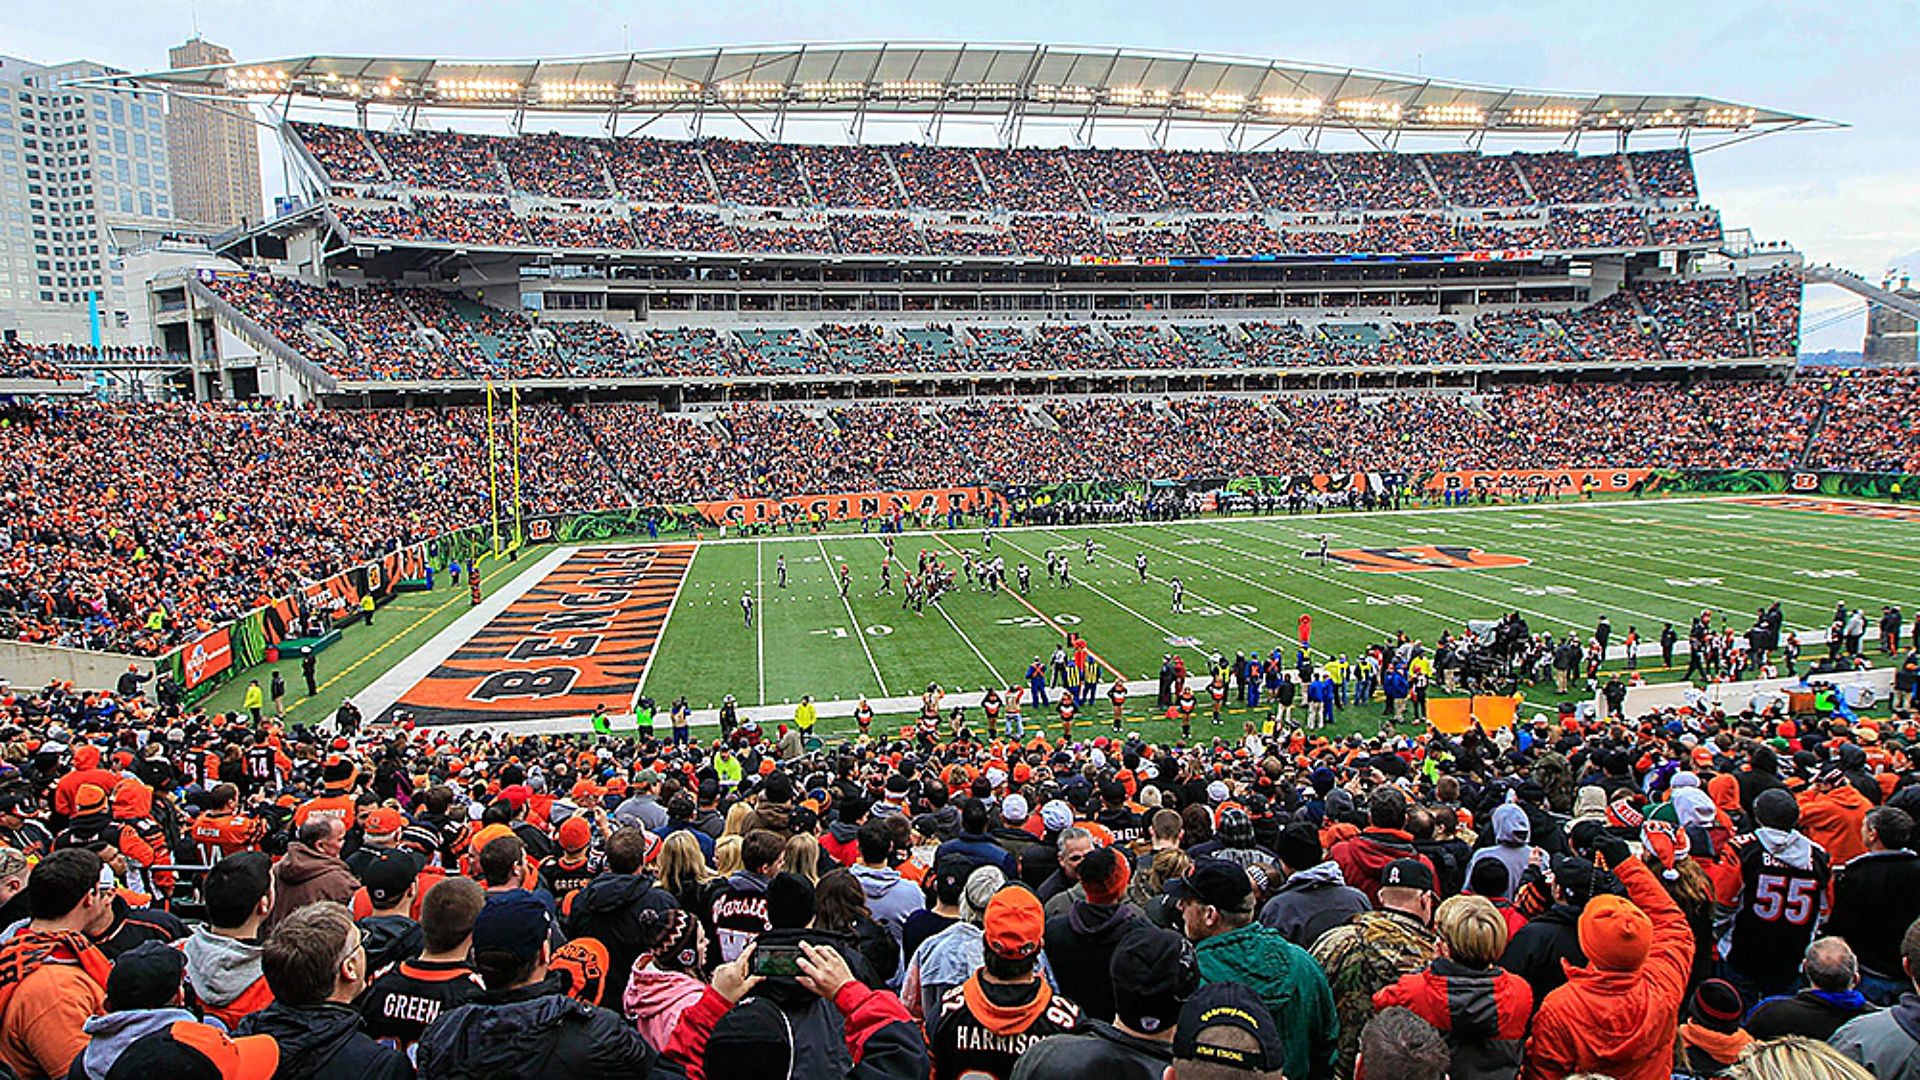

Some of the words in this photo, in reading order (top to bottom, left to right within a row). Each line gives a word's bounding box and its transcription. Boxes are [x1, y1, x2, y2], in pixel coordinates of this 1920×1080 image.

[467, 550, 659, 703] BENGALS
[554, 878, 588, 890] GREE
[1753, 874, 1817, 925] 55
[383, 993, 441, 1023] GREEN
[1046, 996, 1080, 1028] 92
[957, 1025, 1047, 1055] HARRISO
